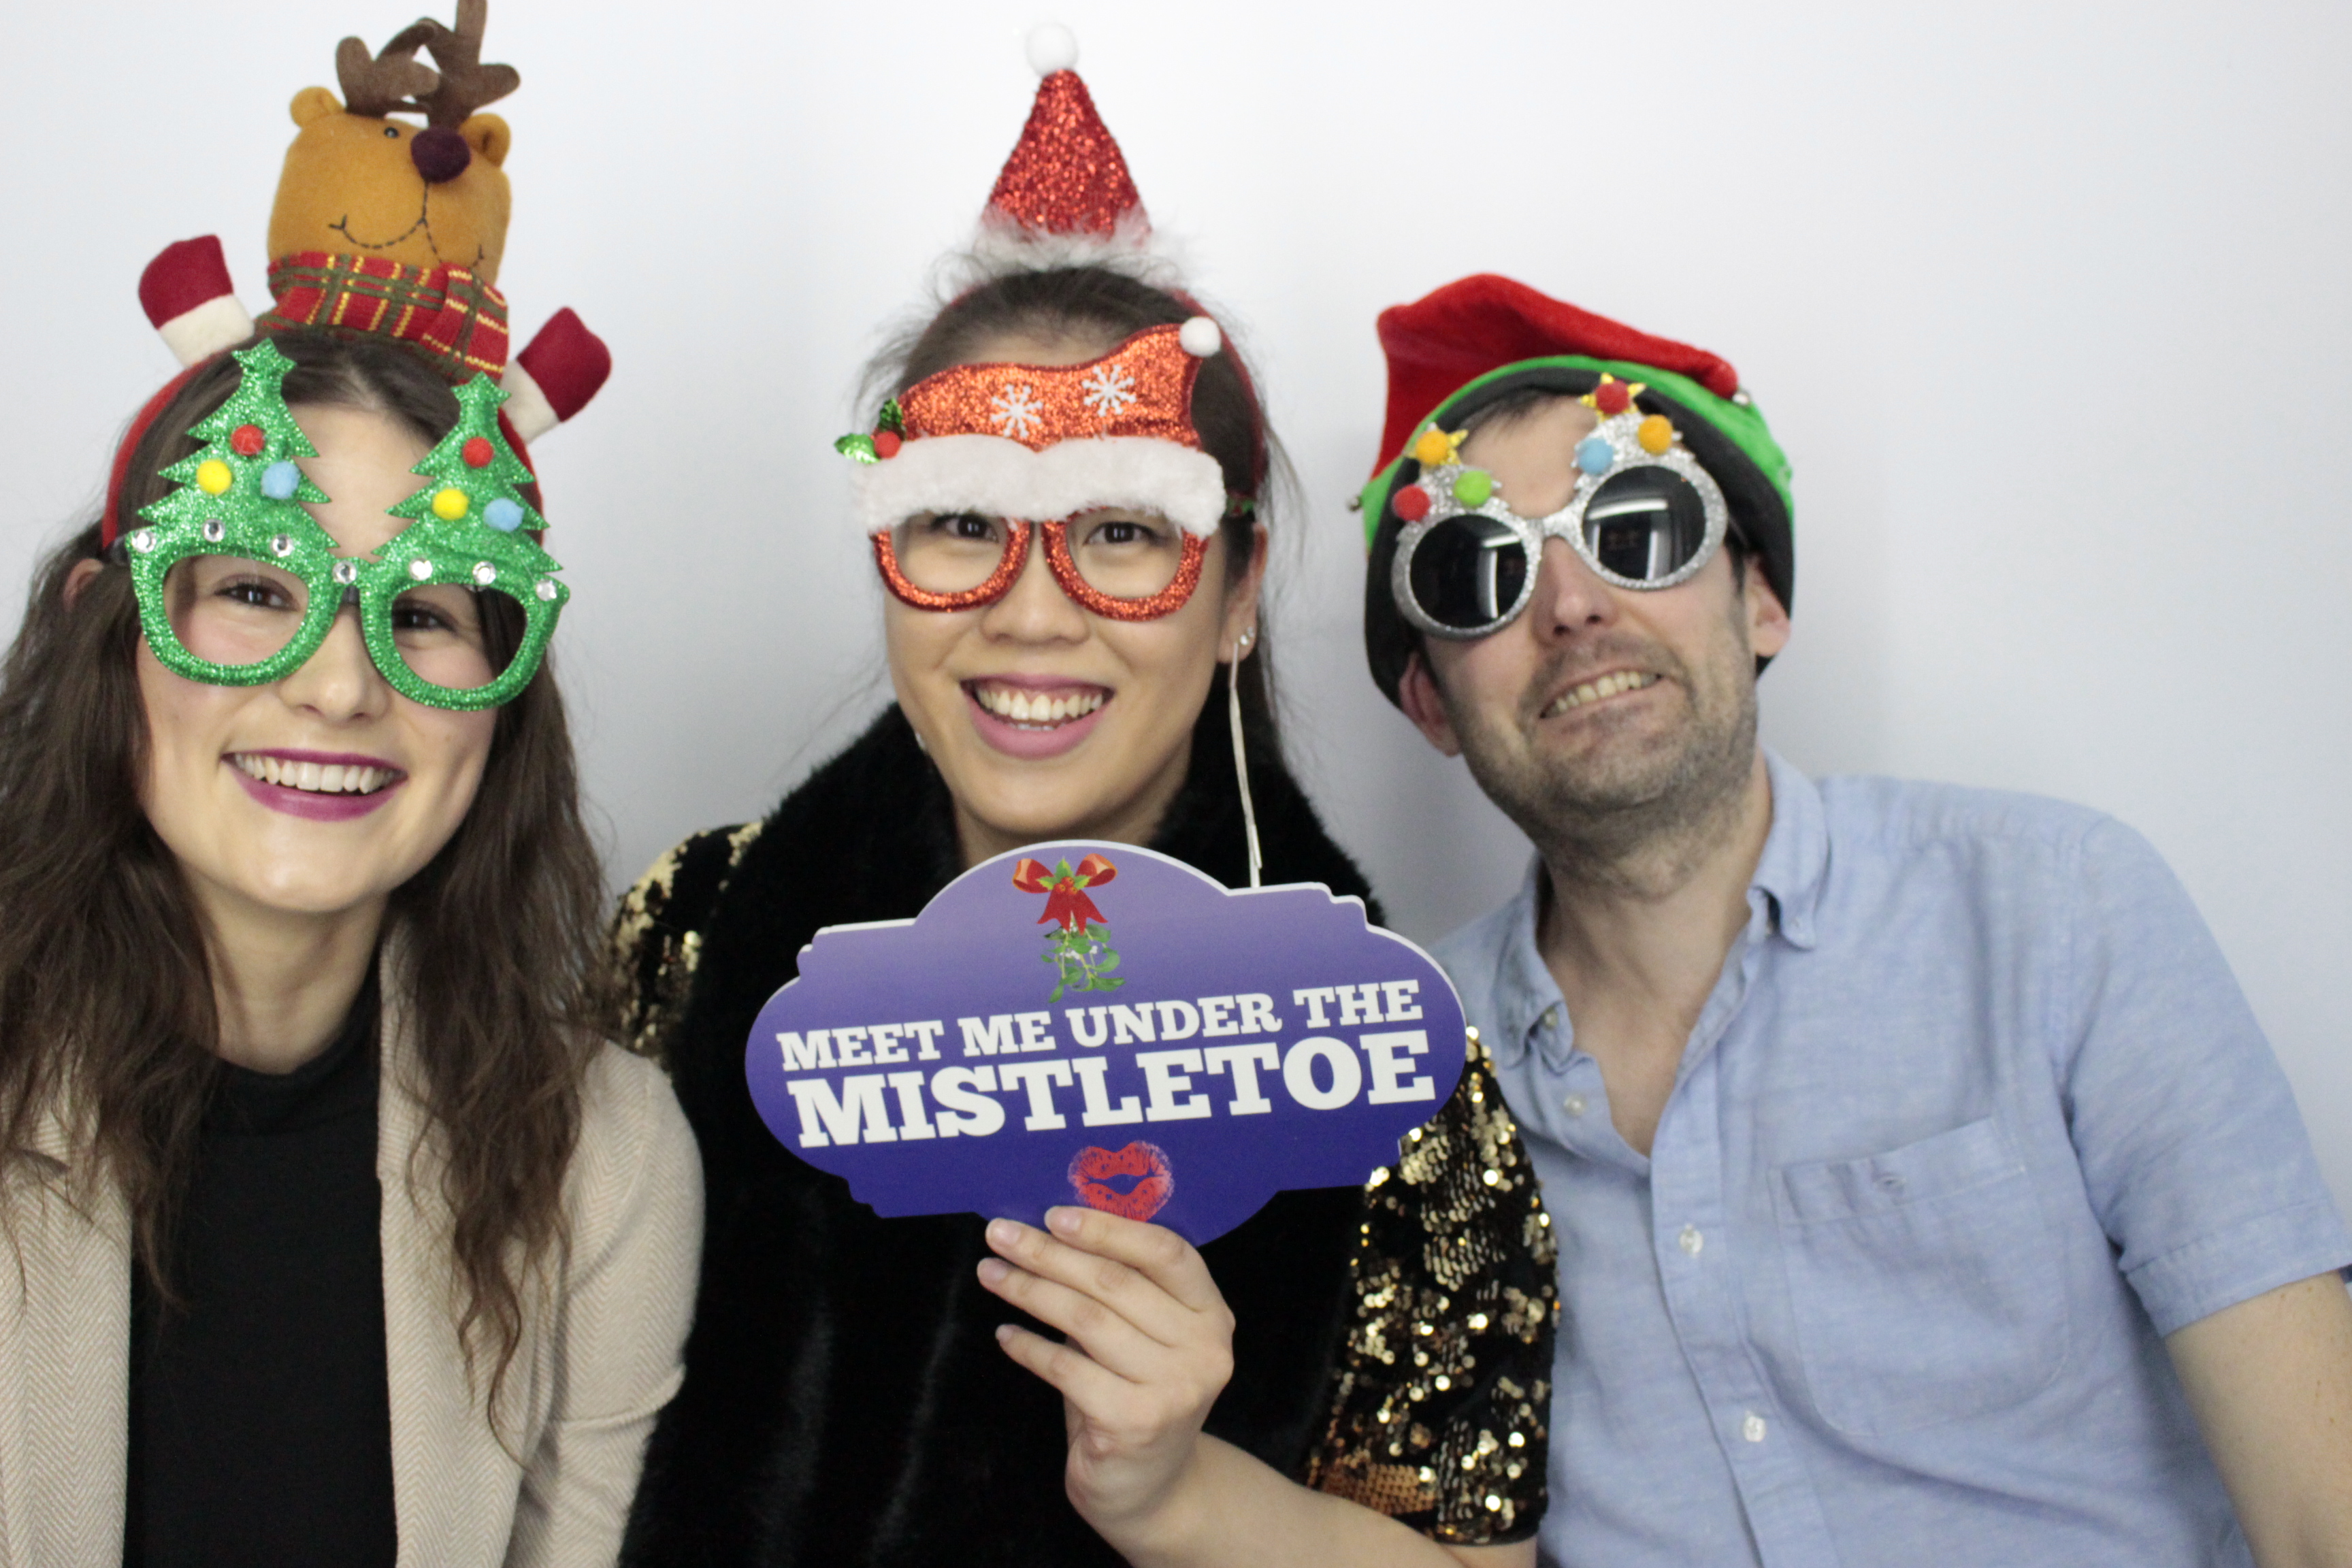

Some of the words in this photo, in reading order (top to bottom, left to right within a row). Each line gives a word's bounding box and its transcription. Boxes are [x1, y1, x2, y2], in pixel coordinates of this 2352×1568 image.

[776, 1019, 944, 1071] MEET
[957, 1011, 1056, 1056] ME
[1065, 993, 1282, 1047] UNDER
[1293, 979, 1422, 1028] THE
[787, 1030, 1435, 1148] MISTLETOE
